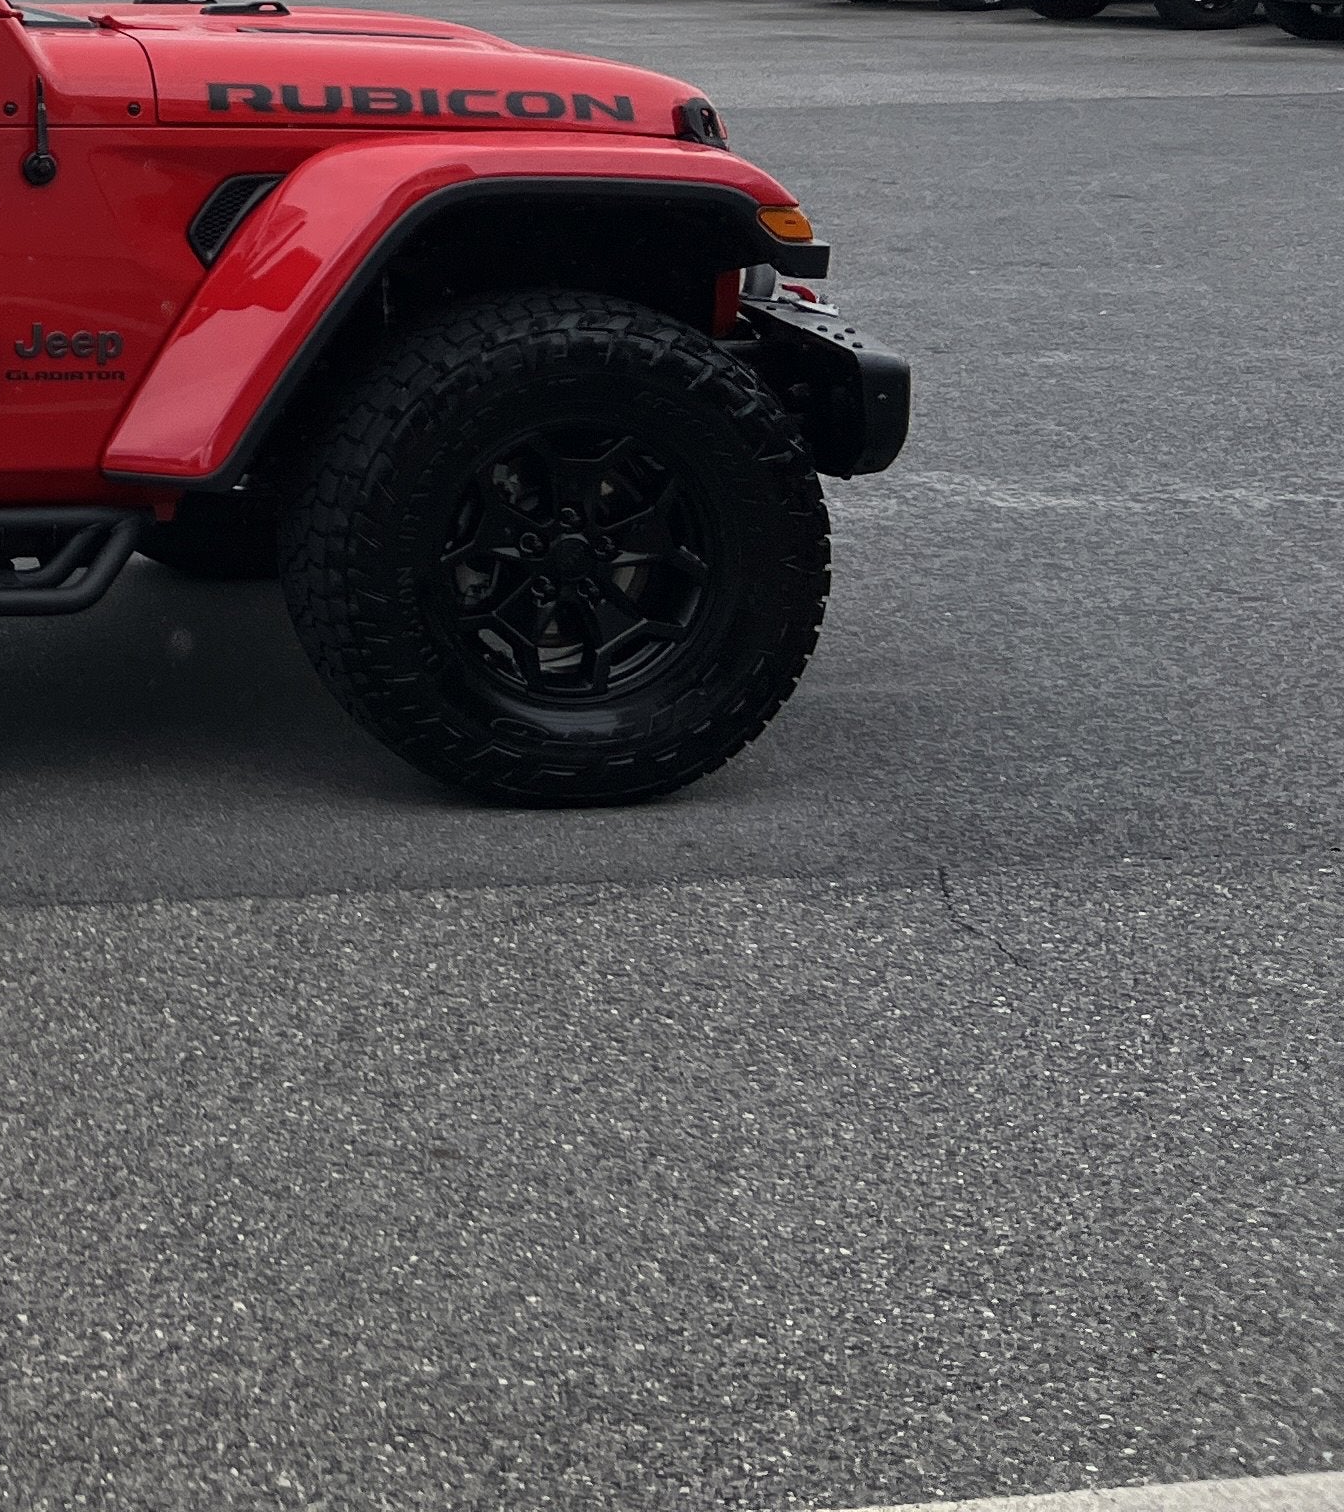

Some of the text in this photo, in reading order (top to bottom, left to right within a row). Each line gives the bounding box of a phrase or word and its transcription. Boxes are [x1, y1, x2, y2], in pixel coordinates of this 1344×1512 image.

[205, 82, 636, 122] RUBICON
[15, 322, 123, 366] Jeep
[5, 369, 125, 381] GLADIATOR
